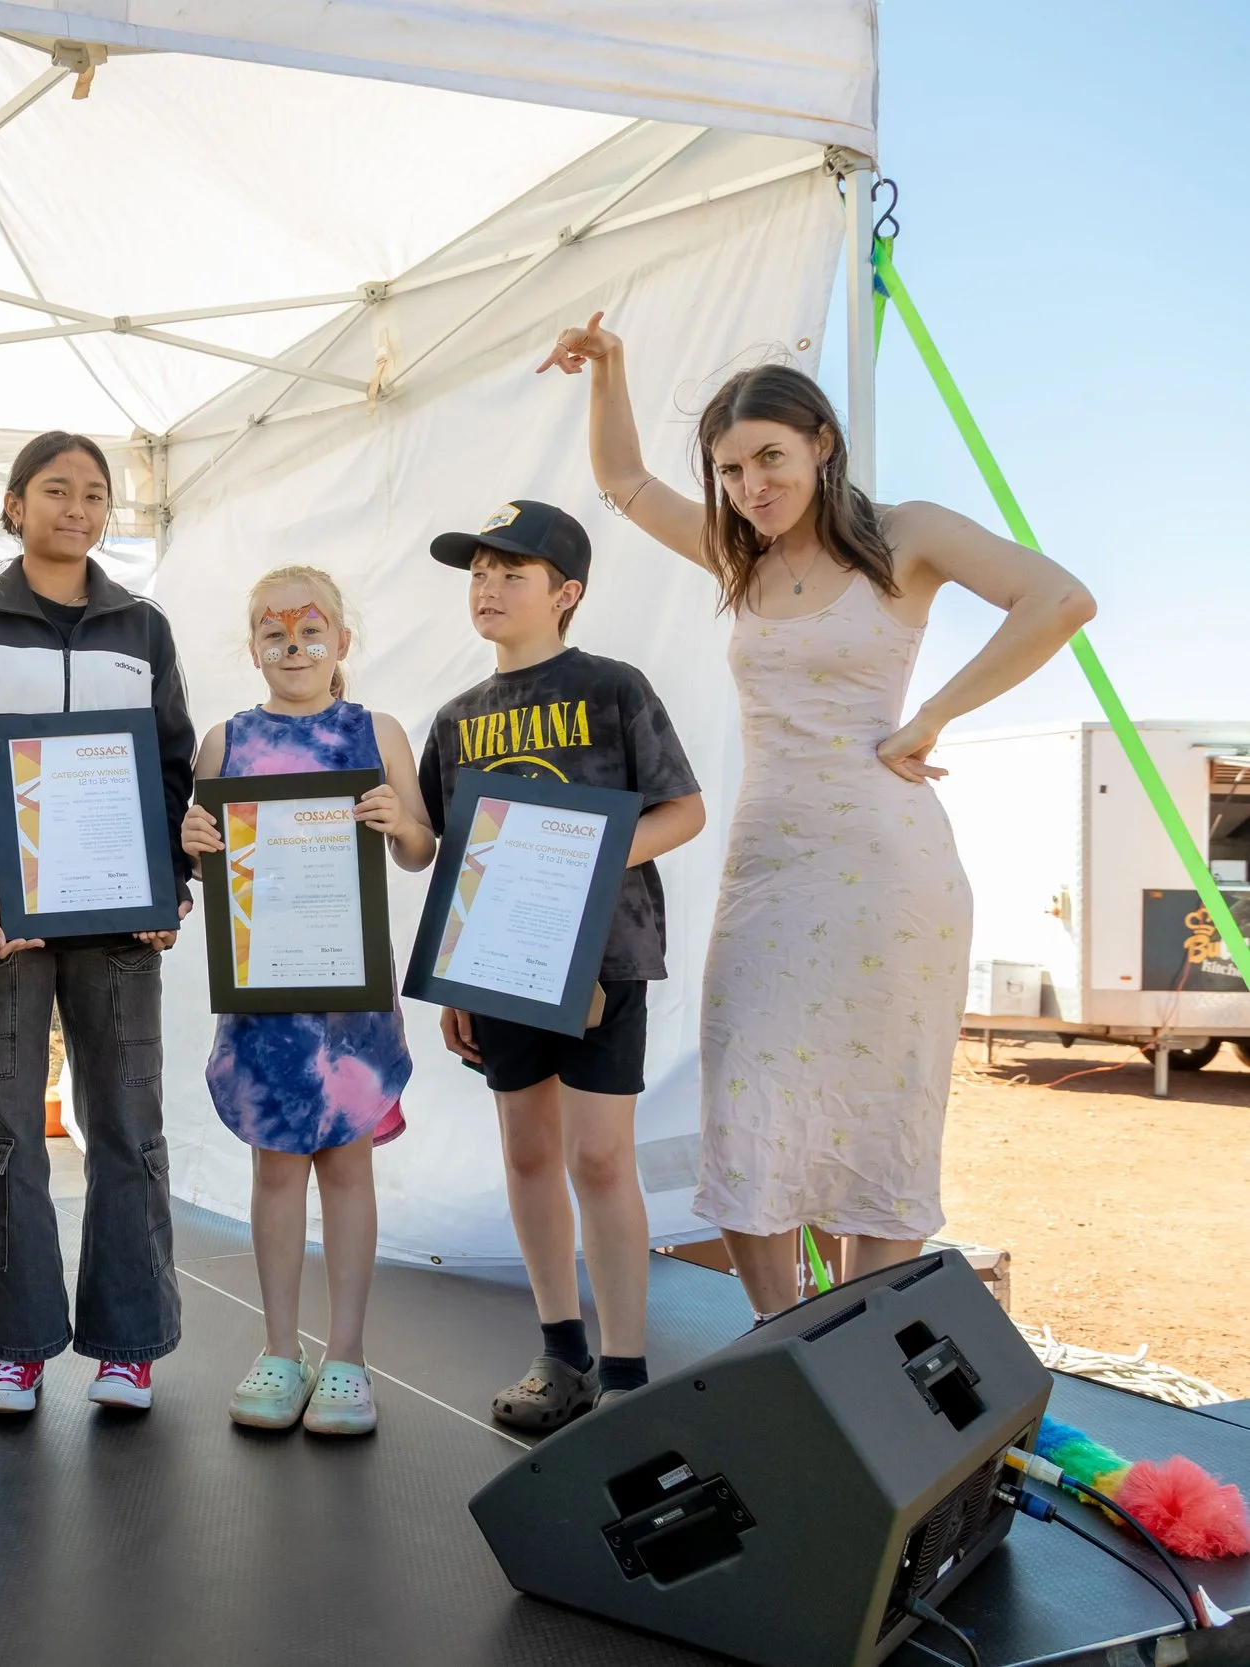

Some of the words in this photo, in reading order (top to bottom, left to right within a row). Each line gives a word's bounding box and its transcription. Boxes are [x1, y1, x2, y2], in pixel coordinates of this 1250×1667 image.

[115, 662, 136, 673] adidas
[458, 700, 592, 765] NIRVANA
[76, 745, 128, 757] COSSACK
[51, 770, 95, 779] CATEGORY
[294, 809, 350, 822] COSSACK
[541, 819, 597, 838] COSSACK
[267, 837, 312, 846] CATEGORY
[315, 835, 351, 844] WINNER
[301, 845, 307, 853] 5
[329, 844, 351, 852] Years
[504, 839, 535, 850] HIGHLY
[535, 844, 590, 860] COMMENDED
[546, 854, 555, 863] to
[566, 857, 588, 868] Years
